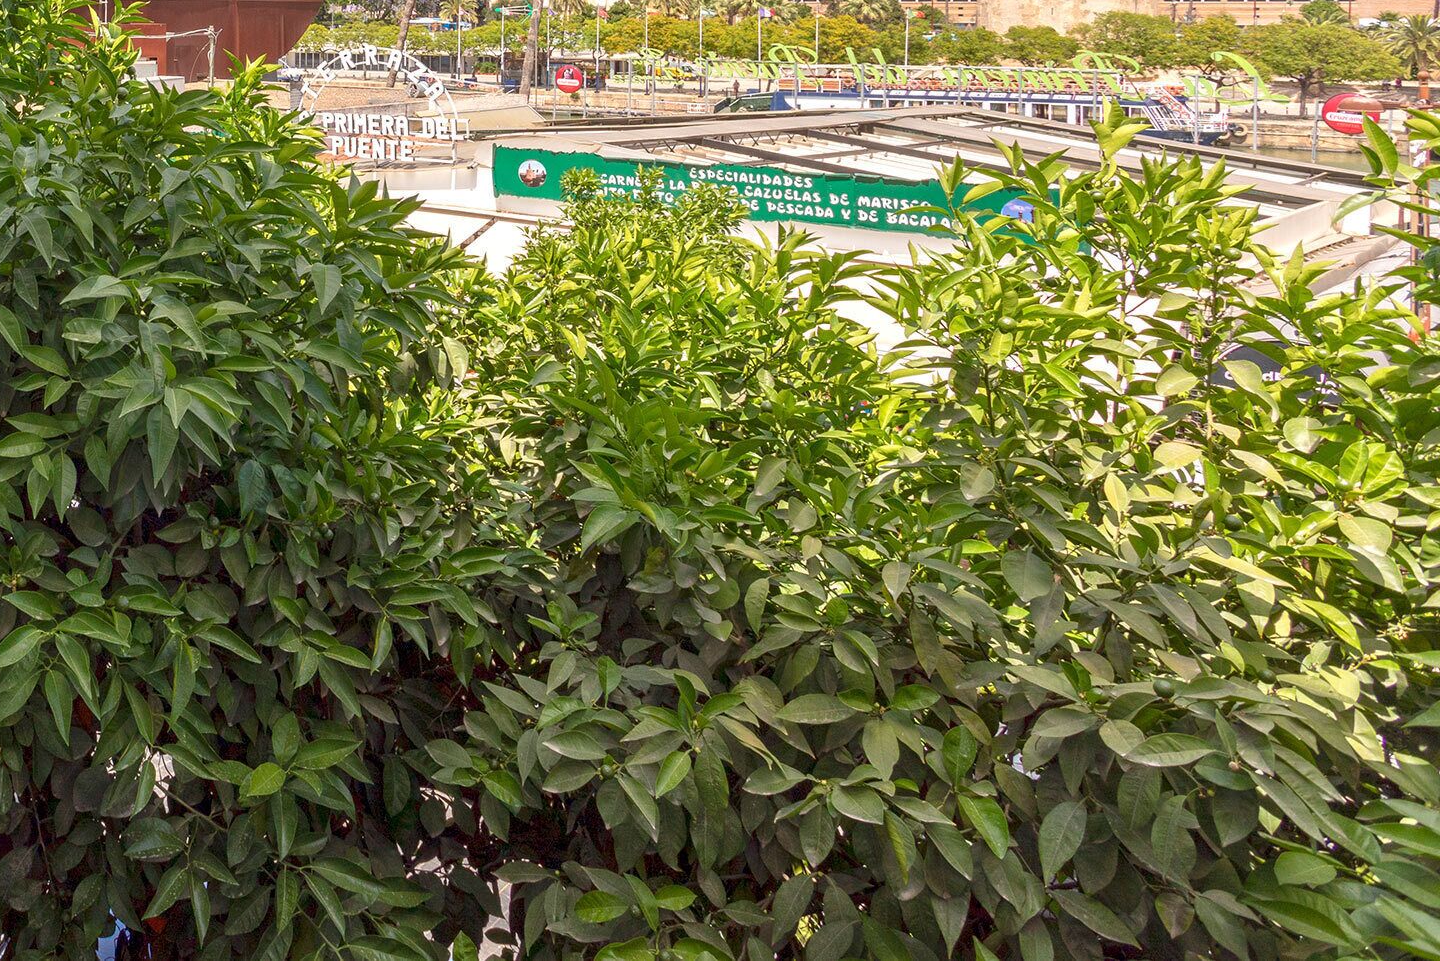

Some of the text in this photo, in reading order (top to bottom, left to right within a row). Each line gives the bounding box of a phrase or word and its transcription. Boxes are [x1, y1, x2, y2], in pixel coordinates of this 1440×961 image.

[301, 43, 445, 111] TERRAZA
[322, 112, 409, 137] PRIMERA
[422, 117, 465, 140] DEL
[331, 136, 416, 162] PUENTE
[689, 167, 813, 189] ESPECIALIDADES
[669, 180, 686, 191] LA
[744, 185, 822, 203] CAZUELAS
[829, 193, 850, 206] DE
[766, 202, 834, 218] PESCADA
[841, 209, 851, 220] Y
[857, 210, 879, 222] DE
